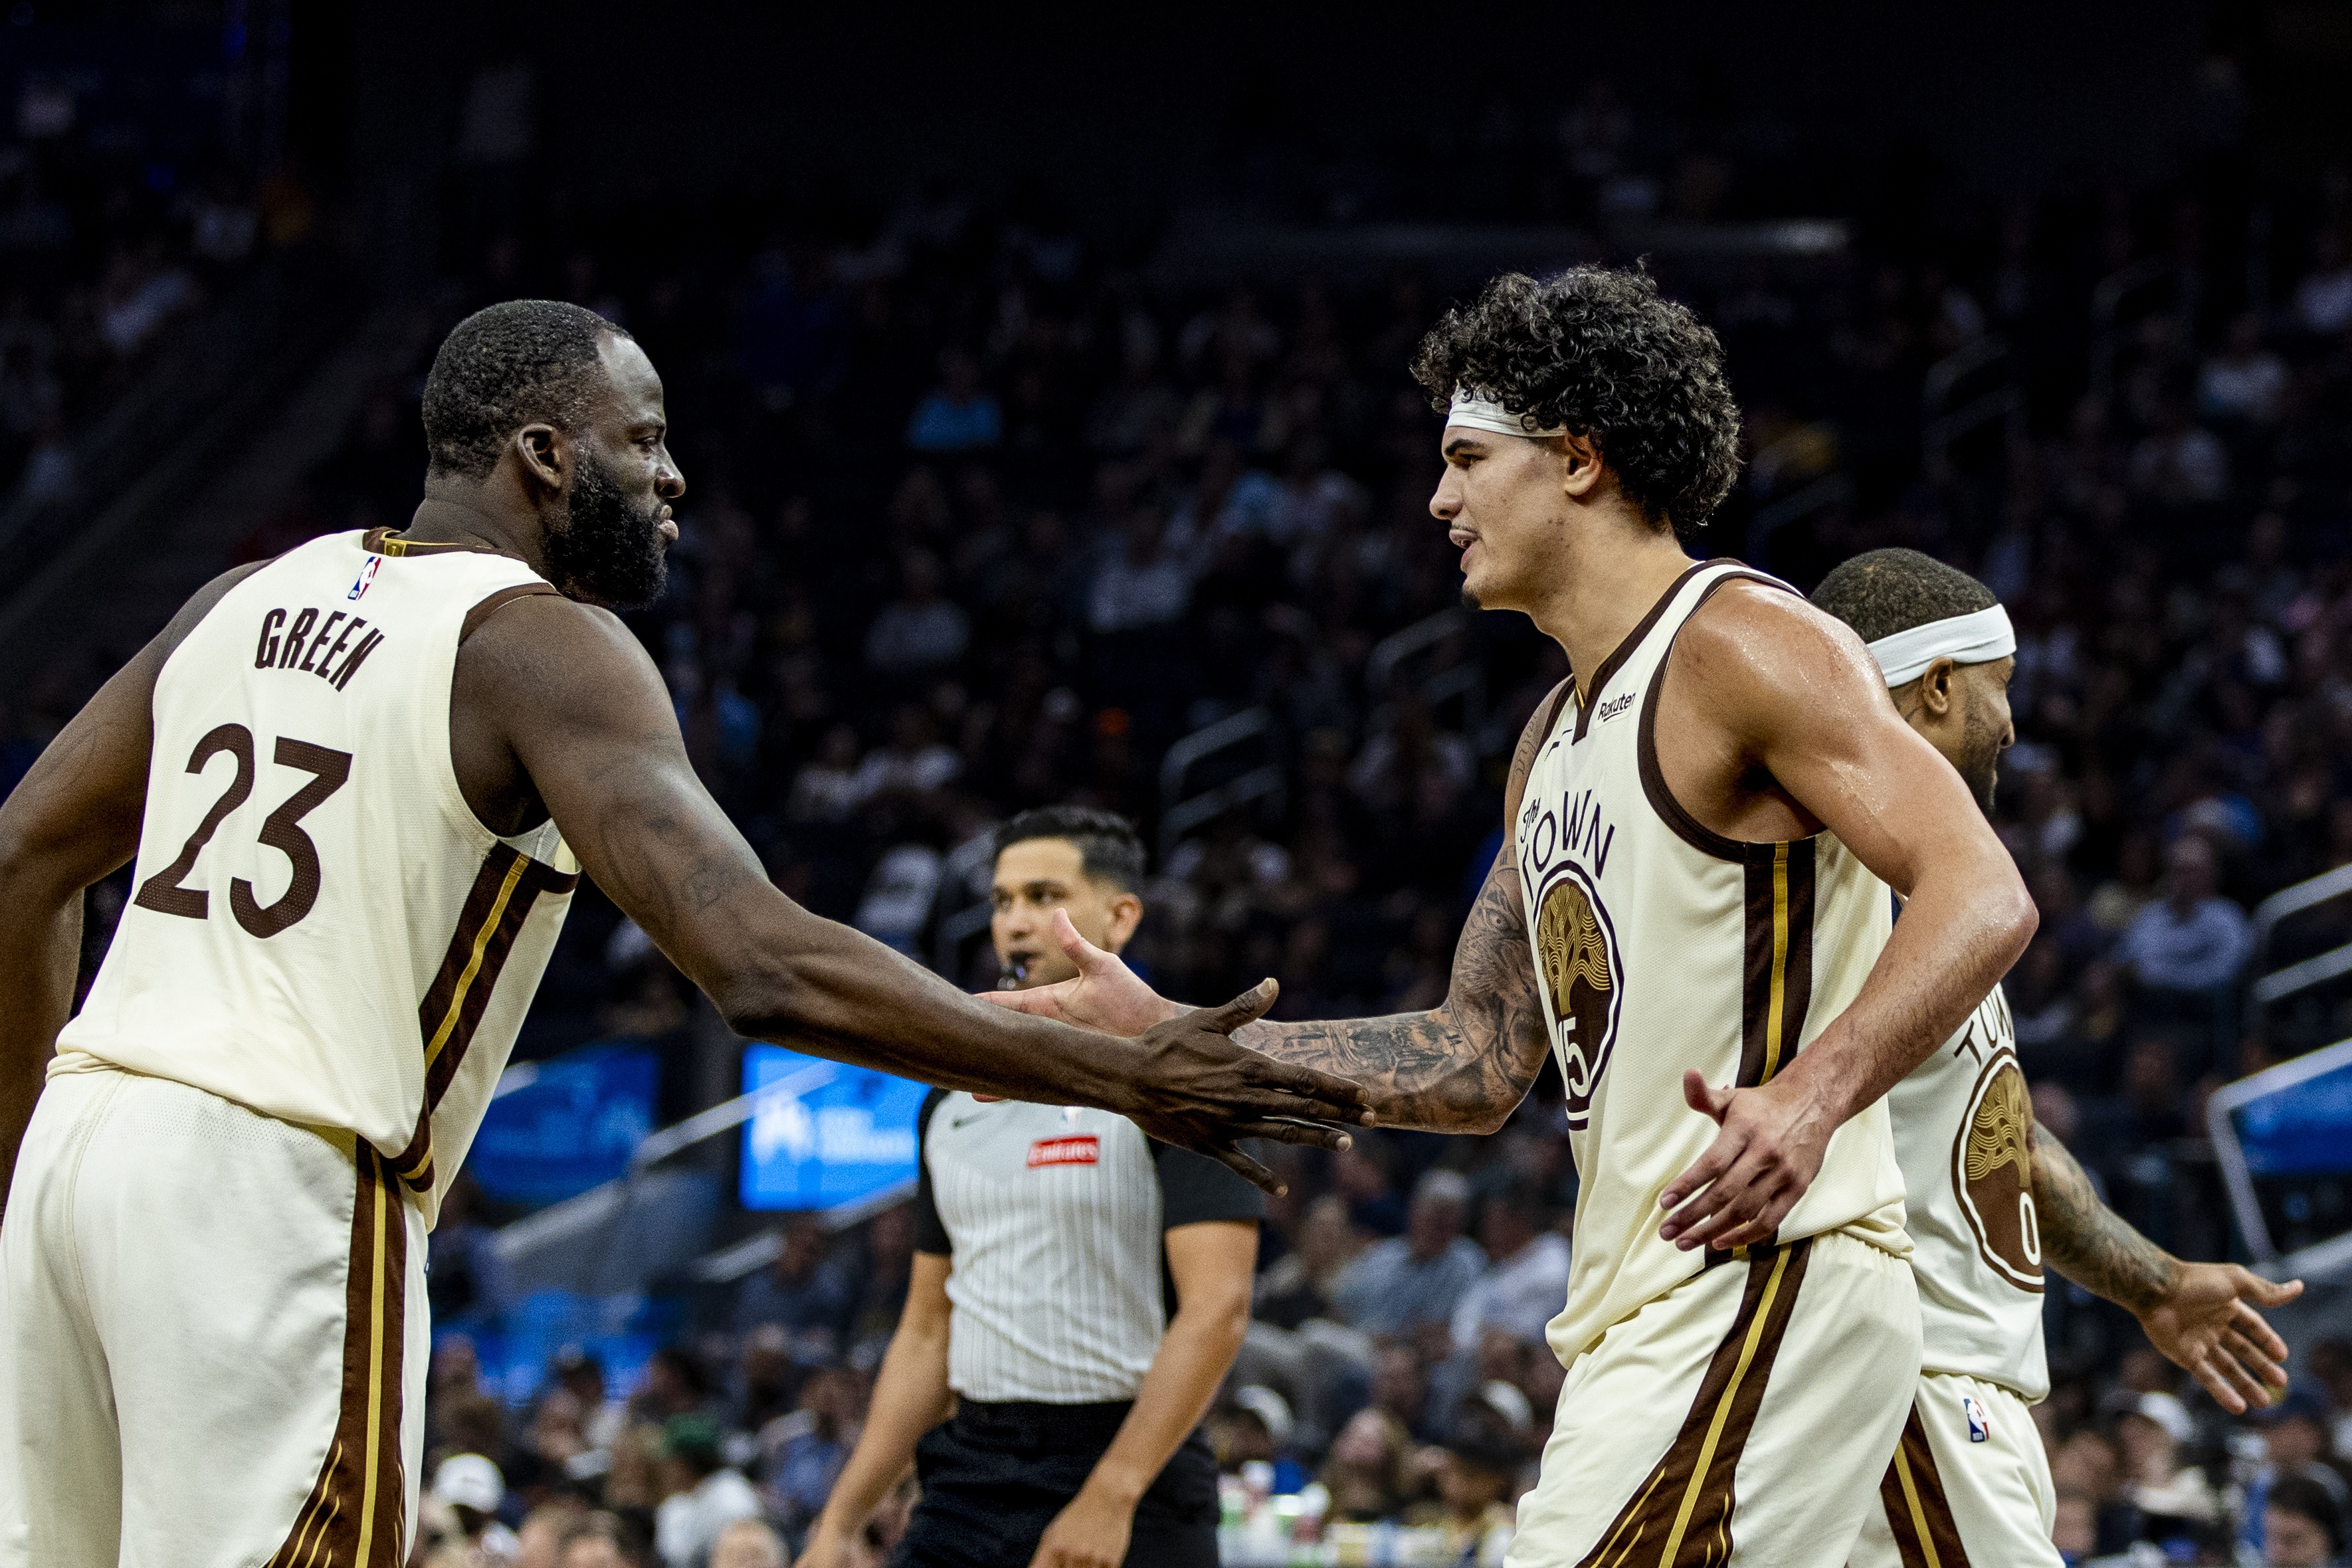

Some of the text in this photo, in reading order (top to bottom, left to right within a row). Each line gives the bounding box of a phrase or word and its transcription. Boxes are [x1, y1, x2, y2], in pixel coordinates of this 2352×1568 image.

[254, 607, 385, 692] GREEN
[133, 722, 353, 939] 23
[1521, 789, 1616, 906] TOWN
[1558, 1016, 1590, 1100] 15
[2019, 1191, 2042, 1266] 0
